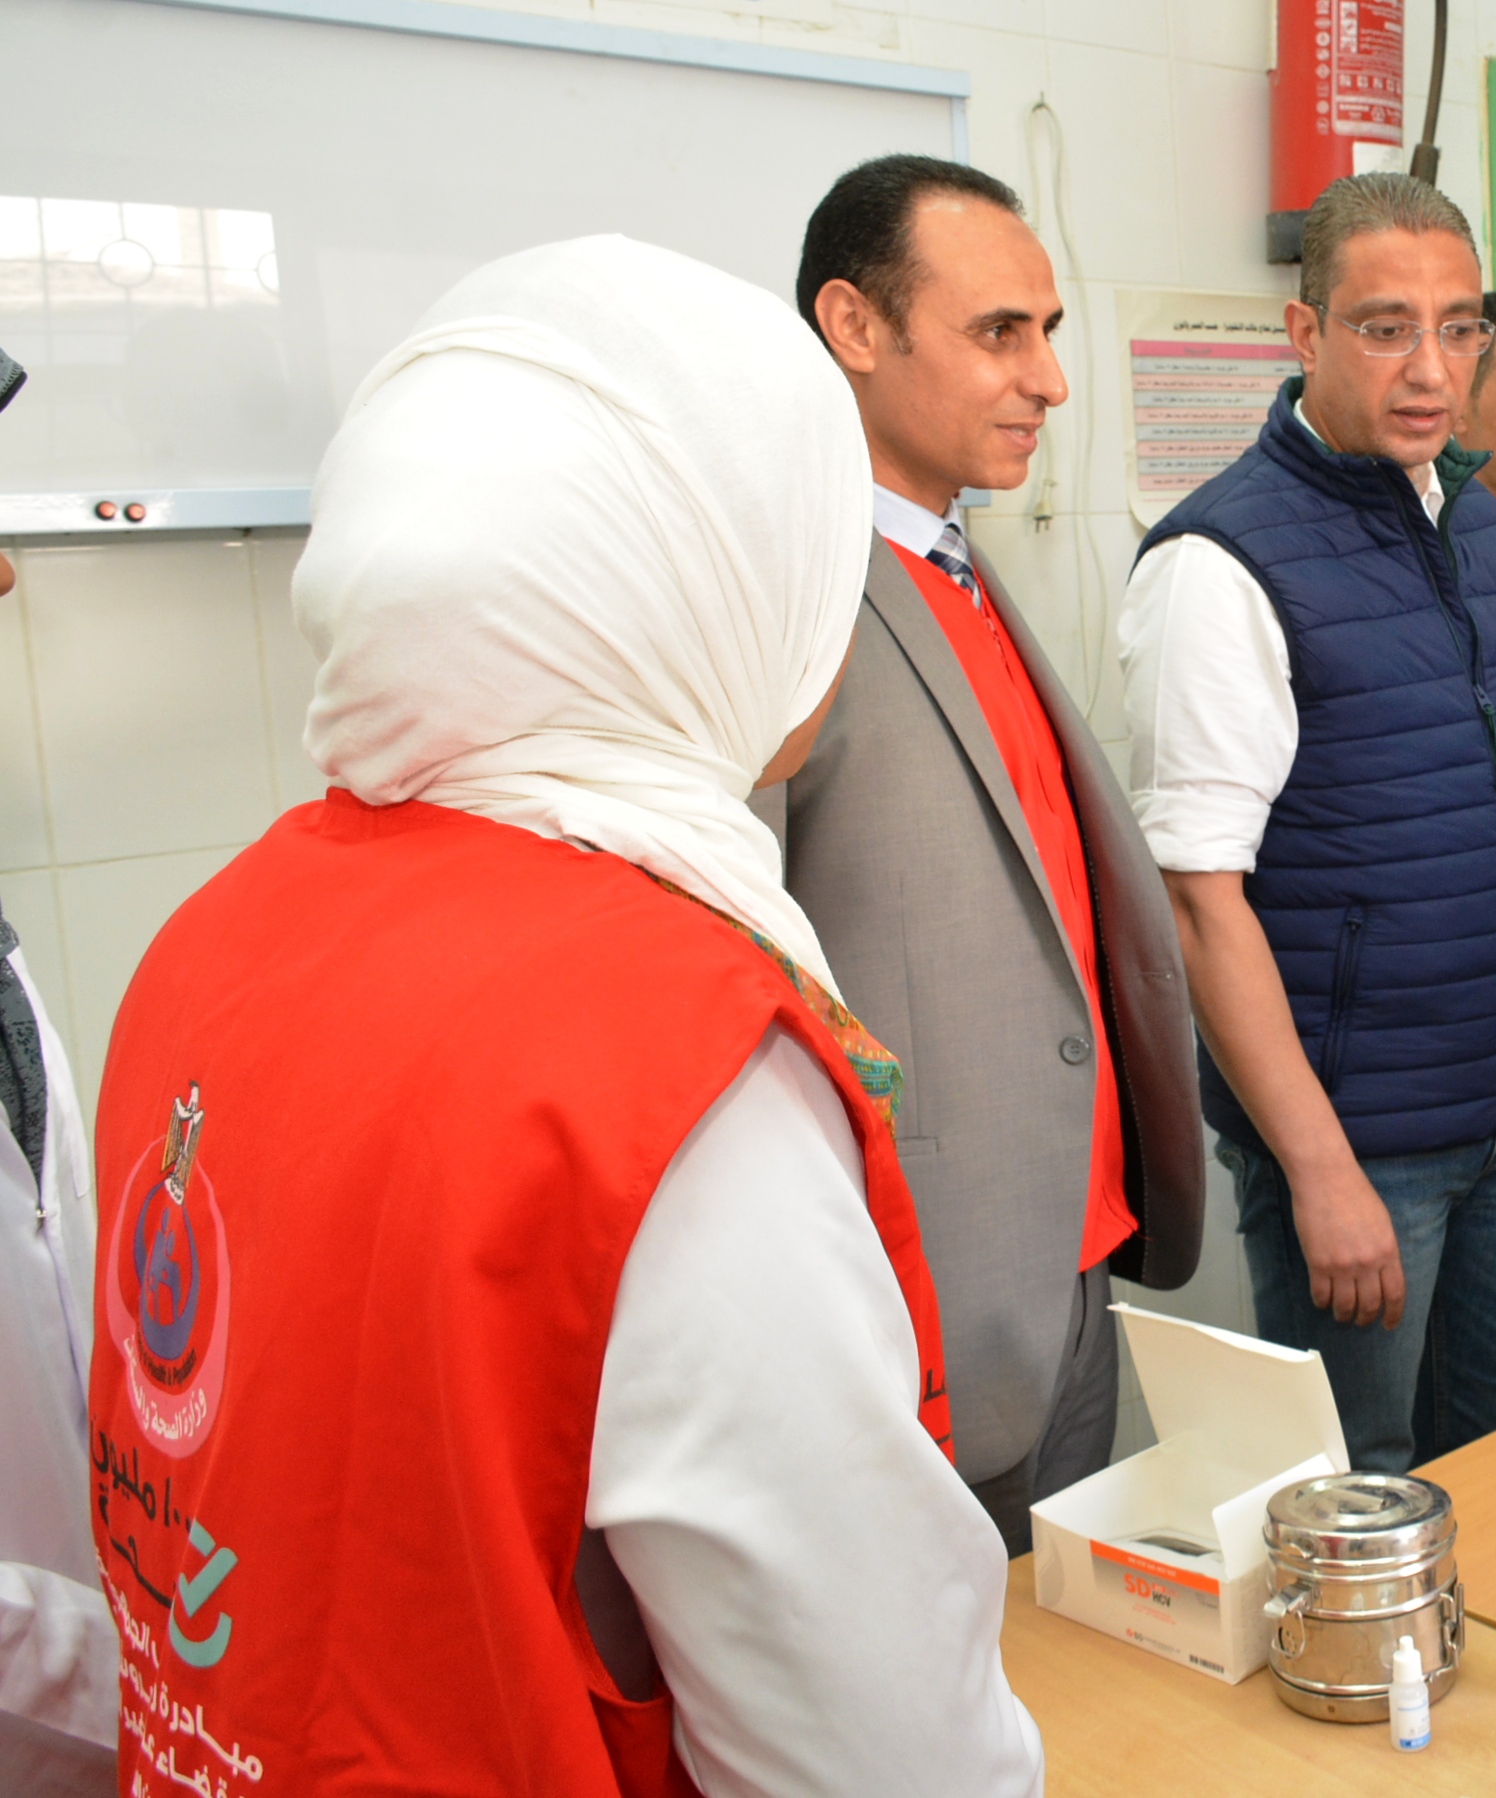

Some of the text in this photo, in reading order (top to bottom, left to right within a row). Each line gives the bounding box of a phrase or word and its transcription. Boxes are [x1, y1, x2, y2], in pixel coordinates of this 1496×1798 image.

[150, 1400, 183, 1440] الصحة
[183, 1387, 207, 1437] وزارة
[91, 1413, 157, 1521] مليون
[1124, 1573, 1151, 1598] SD
[159, 1681, 263, 1782] مبادرة
